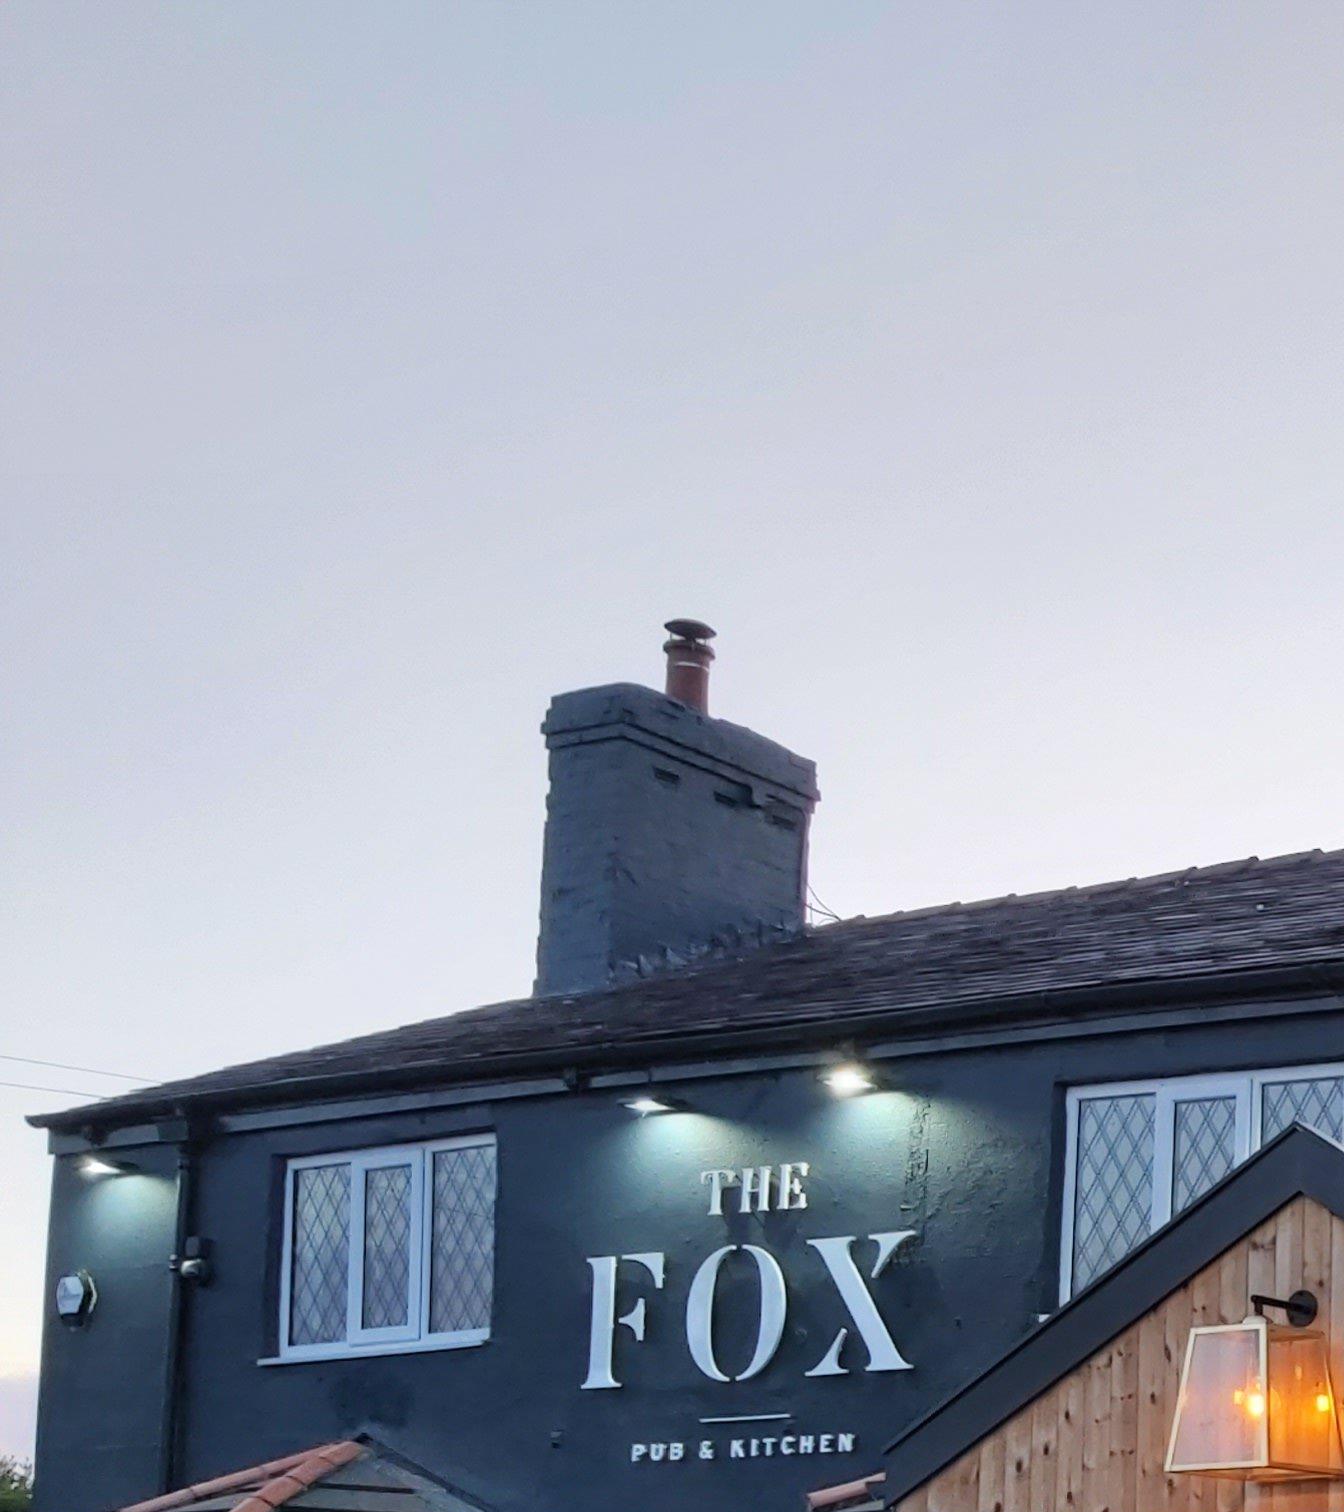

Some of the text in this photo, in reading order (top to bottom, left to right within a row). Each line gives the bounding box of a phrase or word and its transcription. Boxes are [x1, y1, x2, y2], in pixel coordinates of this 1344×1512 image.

[701, 1162, 810, 1216] THE
[580, 1230, 918, 1390] FOX
[631, 1433, 855, 1462] PUB & KITCHEN
